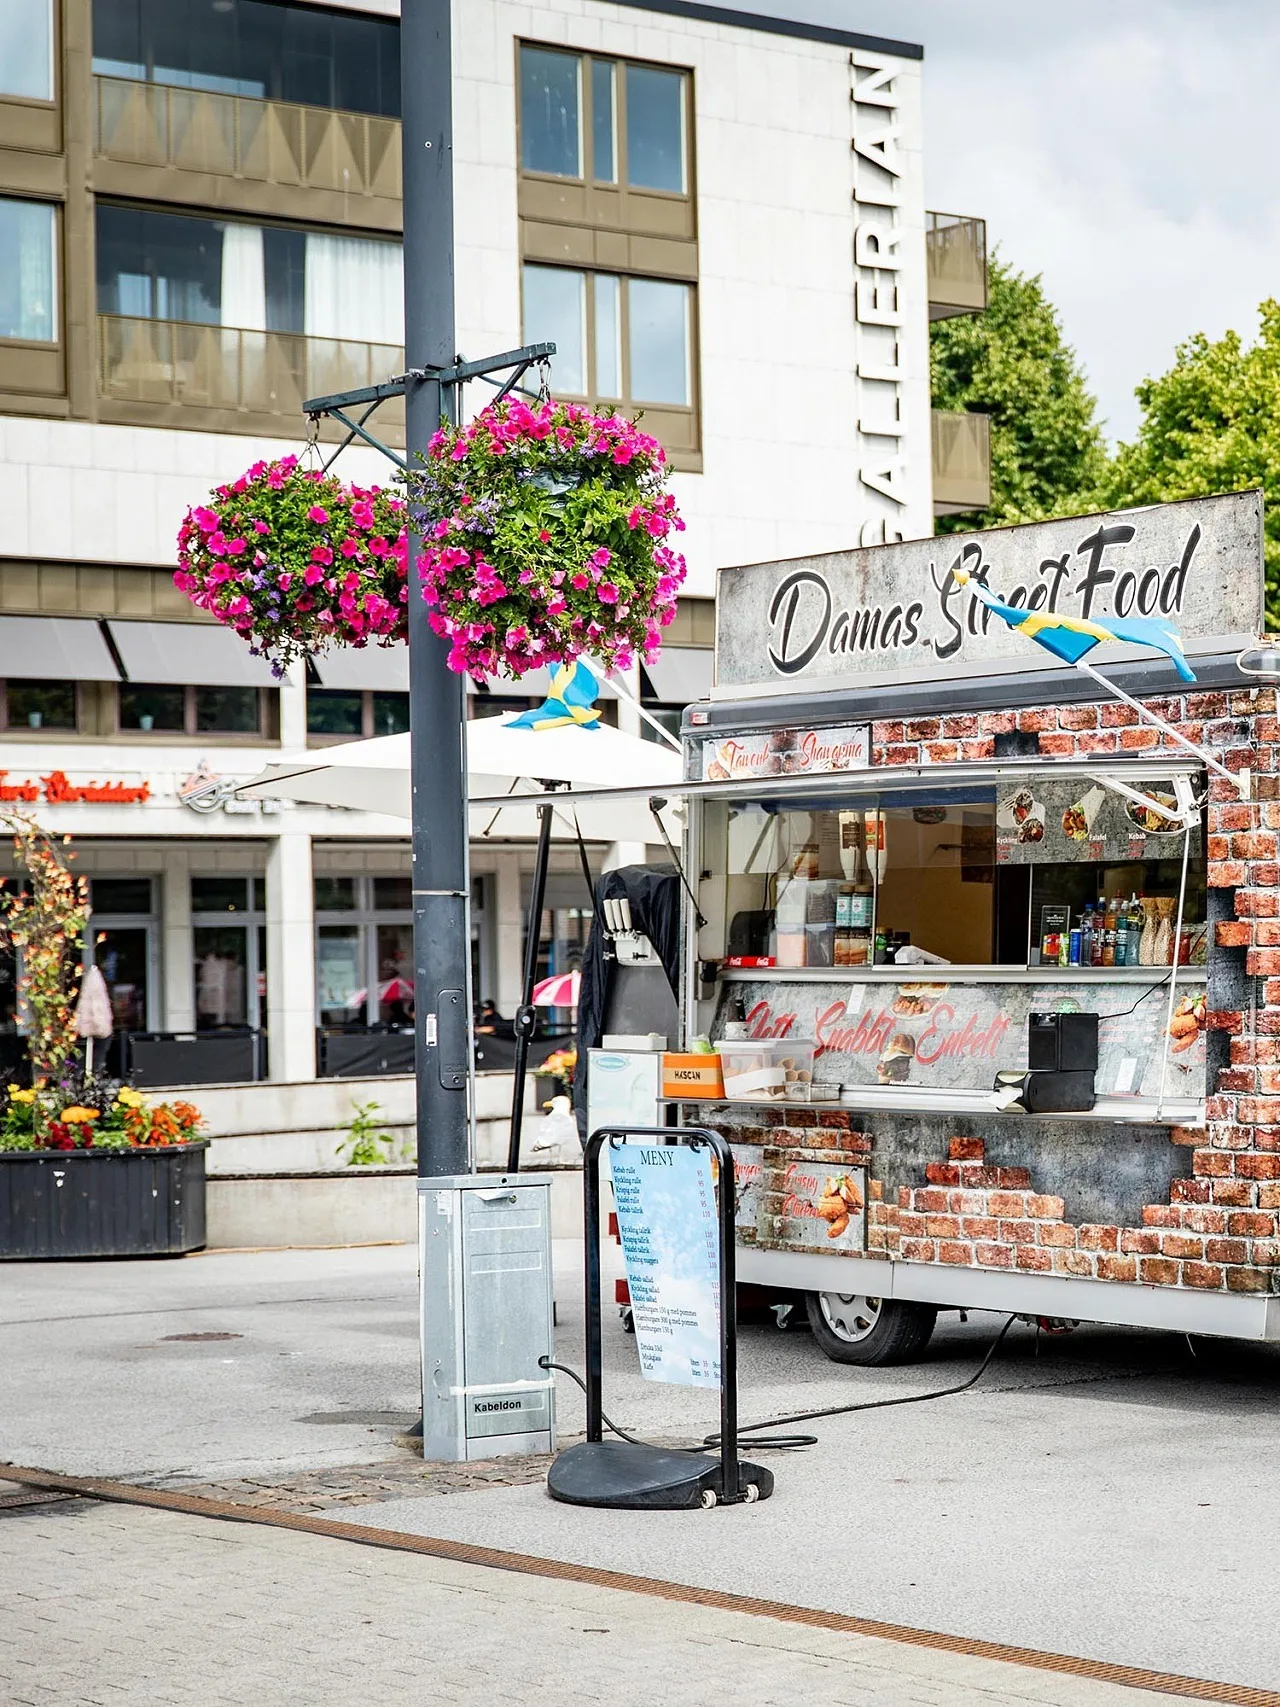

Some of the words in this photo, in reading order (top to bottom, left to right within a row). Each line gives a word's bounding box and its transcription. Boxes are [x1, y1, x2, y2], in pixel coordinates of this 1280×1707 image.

[768, 570, 923, 674] Damas
[1075, 524, 1201, 620] Food
[1128, 832, 1147, 840] Kebab
[813, 1000, 897, 1060] Snabbt
[915, 1002, 1012, 1065] Enkelt
[640, 1150, 674, 1166] MENY
[613, 1166, 625, 1174] Kebab
[614, 1176, 631, 1185] Kyckling
[621, 1226, 638, 1235] Kyckling
[626, 1255, 643, 1264] Kyckling
[474, 1400, 522, 1413] Kabeldon
